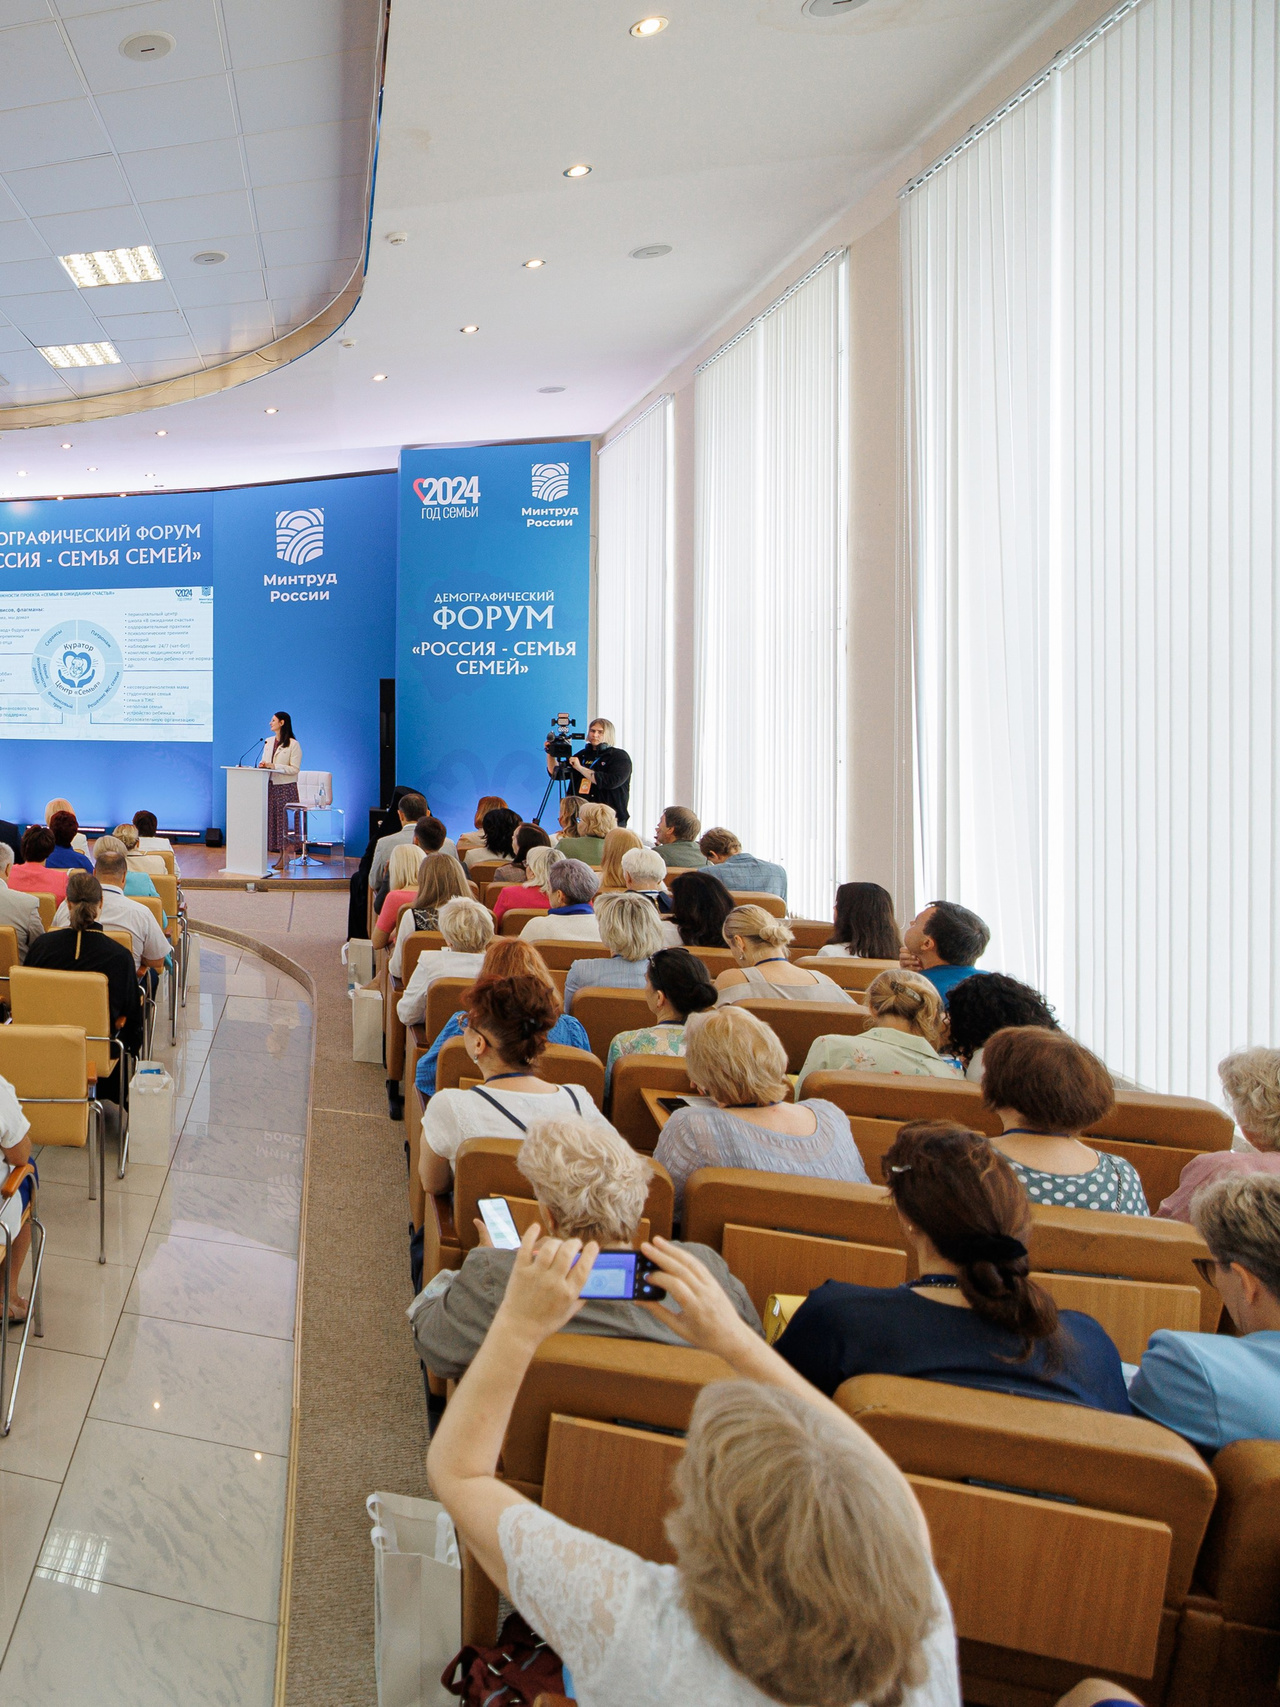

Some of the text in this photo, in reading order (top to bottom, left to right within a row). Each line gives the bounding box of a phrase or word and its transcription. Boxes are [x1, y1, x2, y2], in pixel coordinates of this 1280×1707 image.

[423, 476, 481, 506] 2024
[521, 507, 579, 517] Минтруд
[526, 519, 573, 528] России
[136, 524, 201, 540] ФОРУМ
[58, 549, 119, 567] СЕМЬЯ
[126, 543, 201, 564] СЕМЕЙ»
[263, 574, 338, 587] Минтруд
[270, 590, 330, 603] России
[434, 590, 554, 604] ДЕМОГРАФИЧЕСКИЙ
[432, 605, 555, 632] ФОРУМ
[63, 642, 94, 652] Куратор
[412, 641, 496, 656] «РОССИЯ
[514, 641, 577, 656] СЕМЬЯ
[456, 658, 529, 675] СЕМЕЙ»
[55, 680, 100, 695] Центр «Семья»
